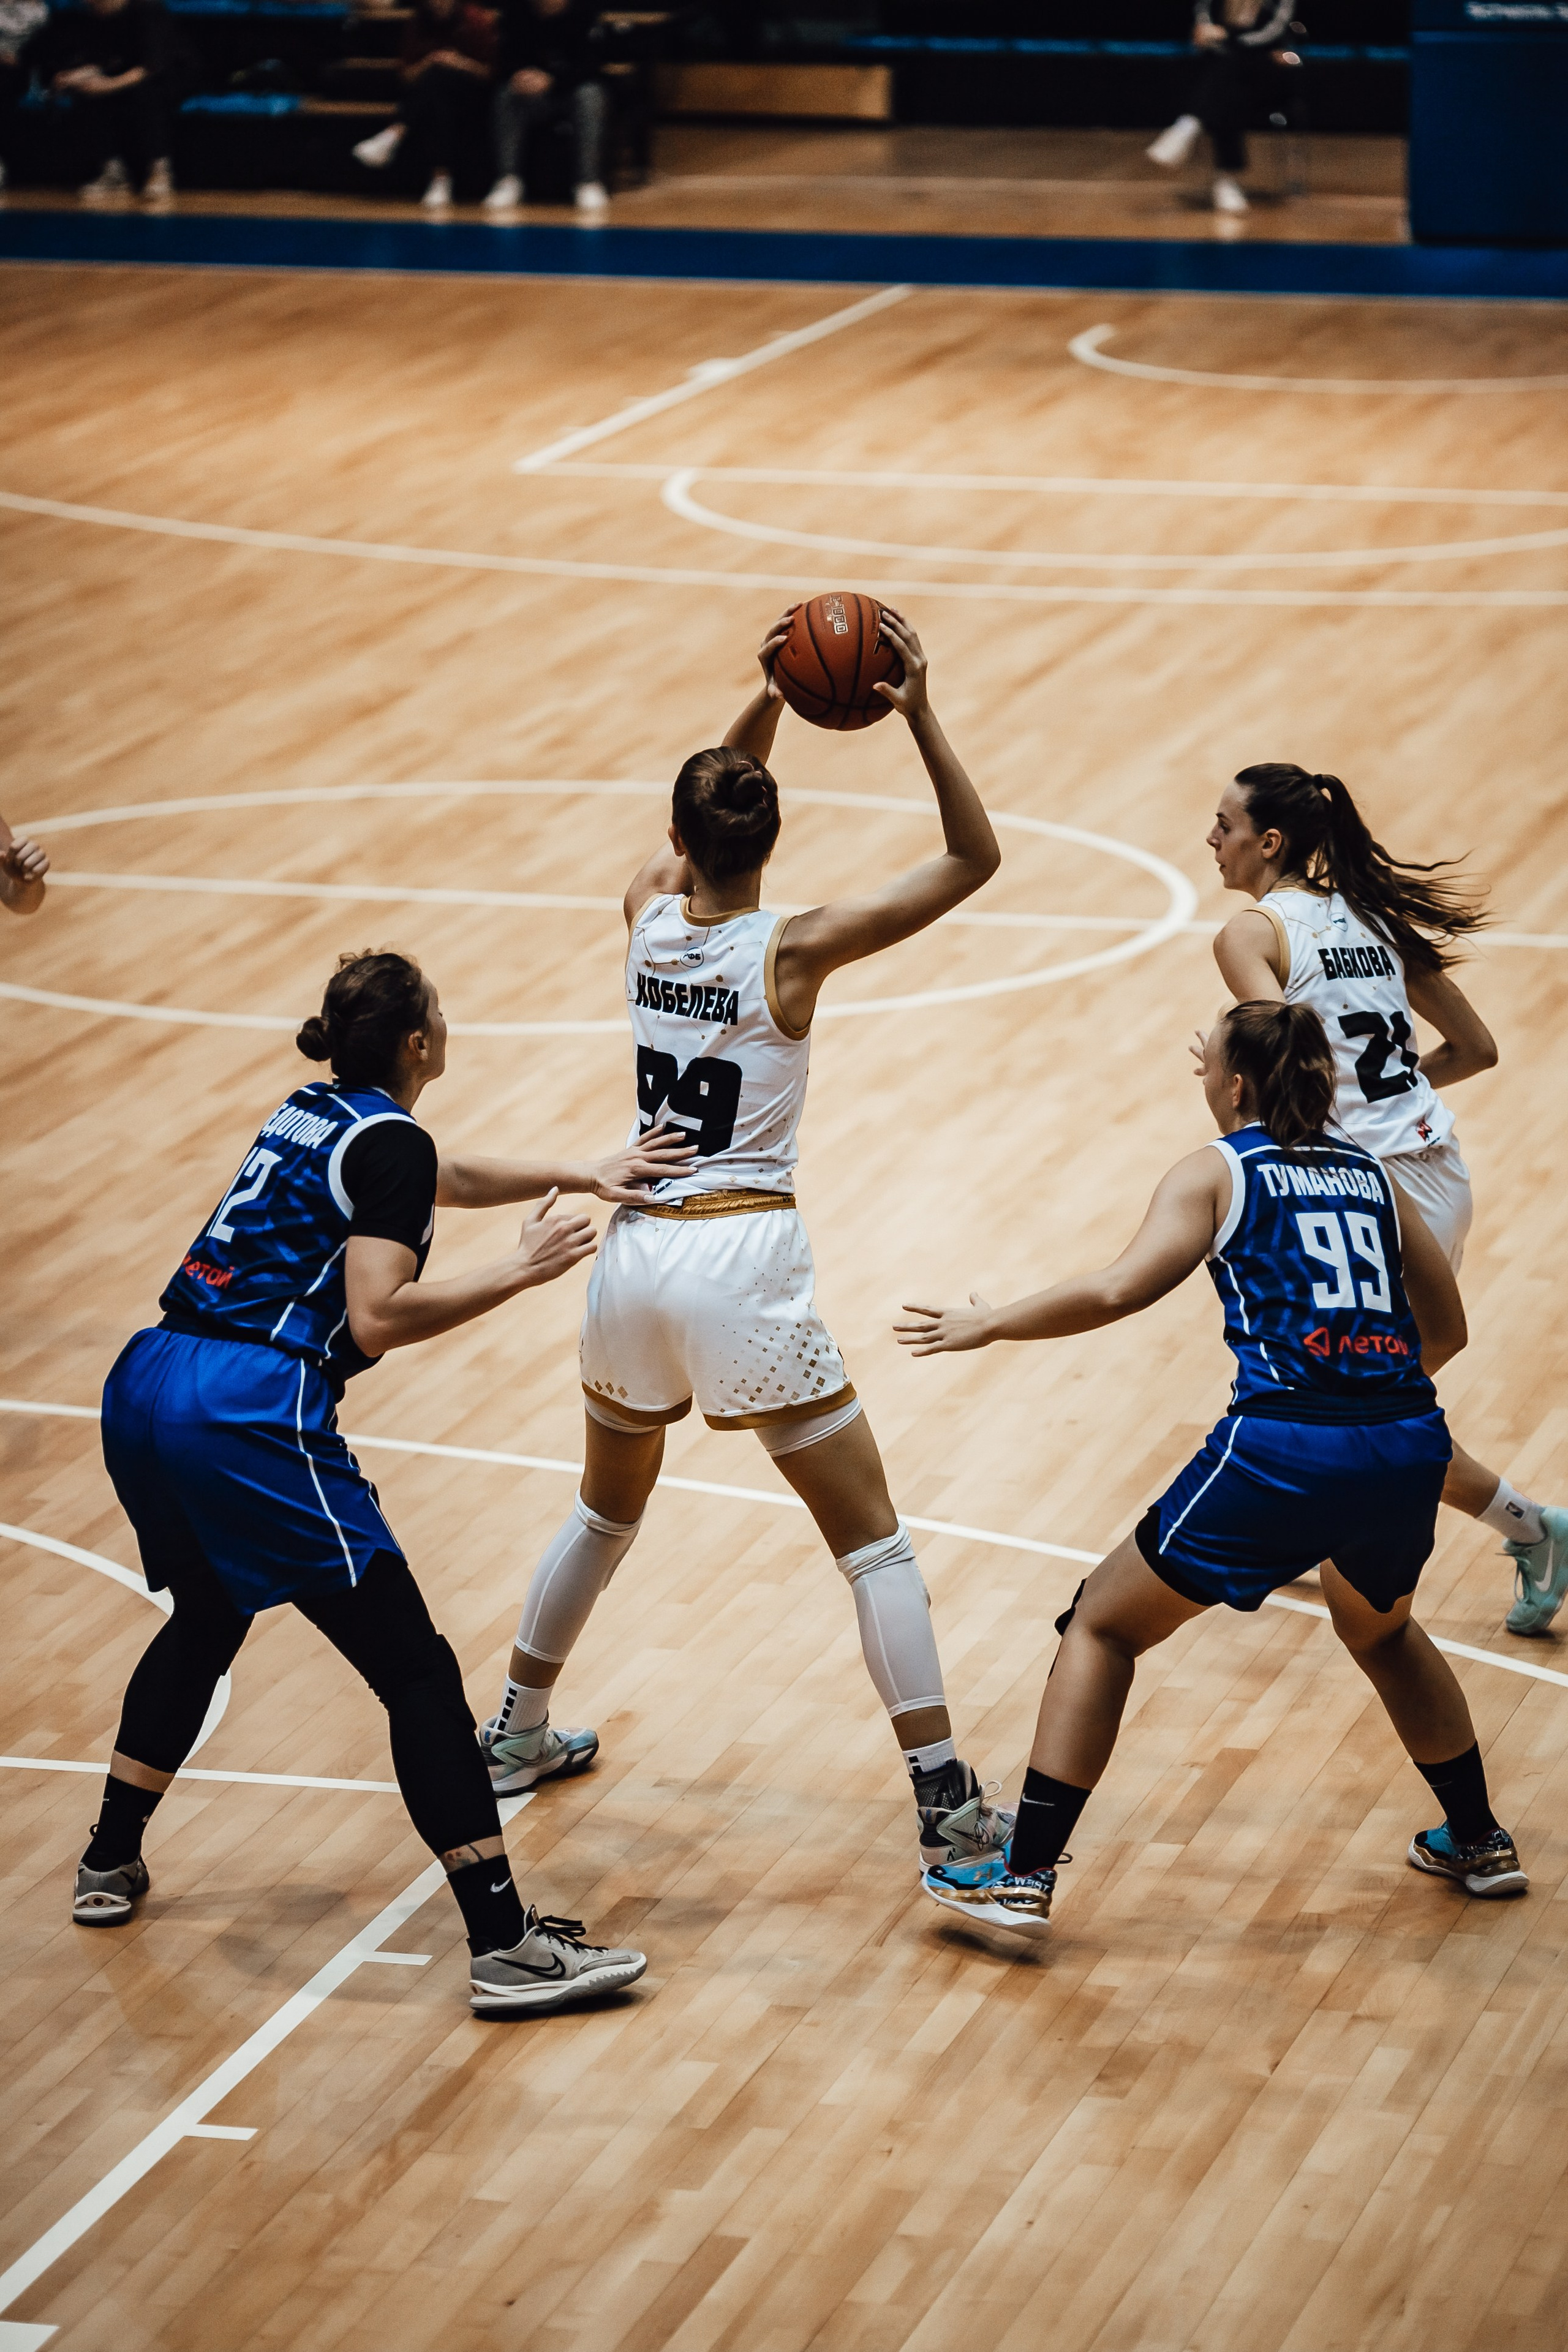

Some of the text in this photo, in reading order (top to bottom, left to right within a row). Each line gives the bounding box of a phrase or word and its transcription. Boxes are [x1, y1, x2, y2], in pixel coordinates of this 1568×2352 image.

[635, 971, 739, 1026] КОБЕЛЕВА
[1317, 945, 1396, 981] БАБКОВА
[637, 1044, 743, 1158] 99
[1337, 1011, 1420, 1104] 21
[206, 1147, 283, 1243] 12
[1257, 1163, 1385, 1205] ТУМАНОВА
[1295, 1211, 1392, 1313] 99
